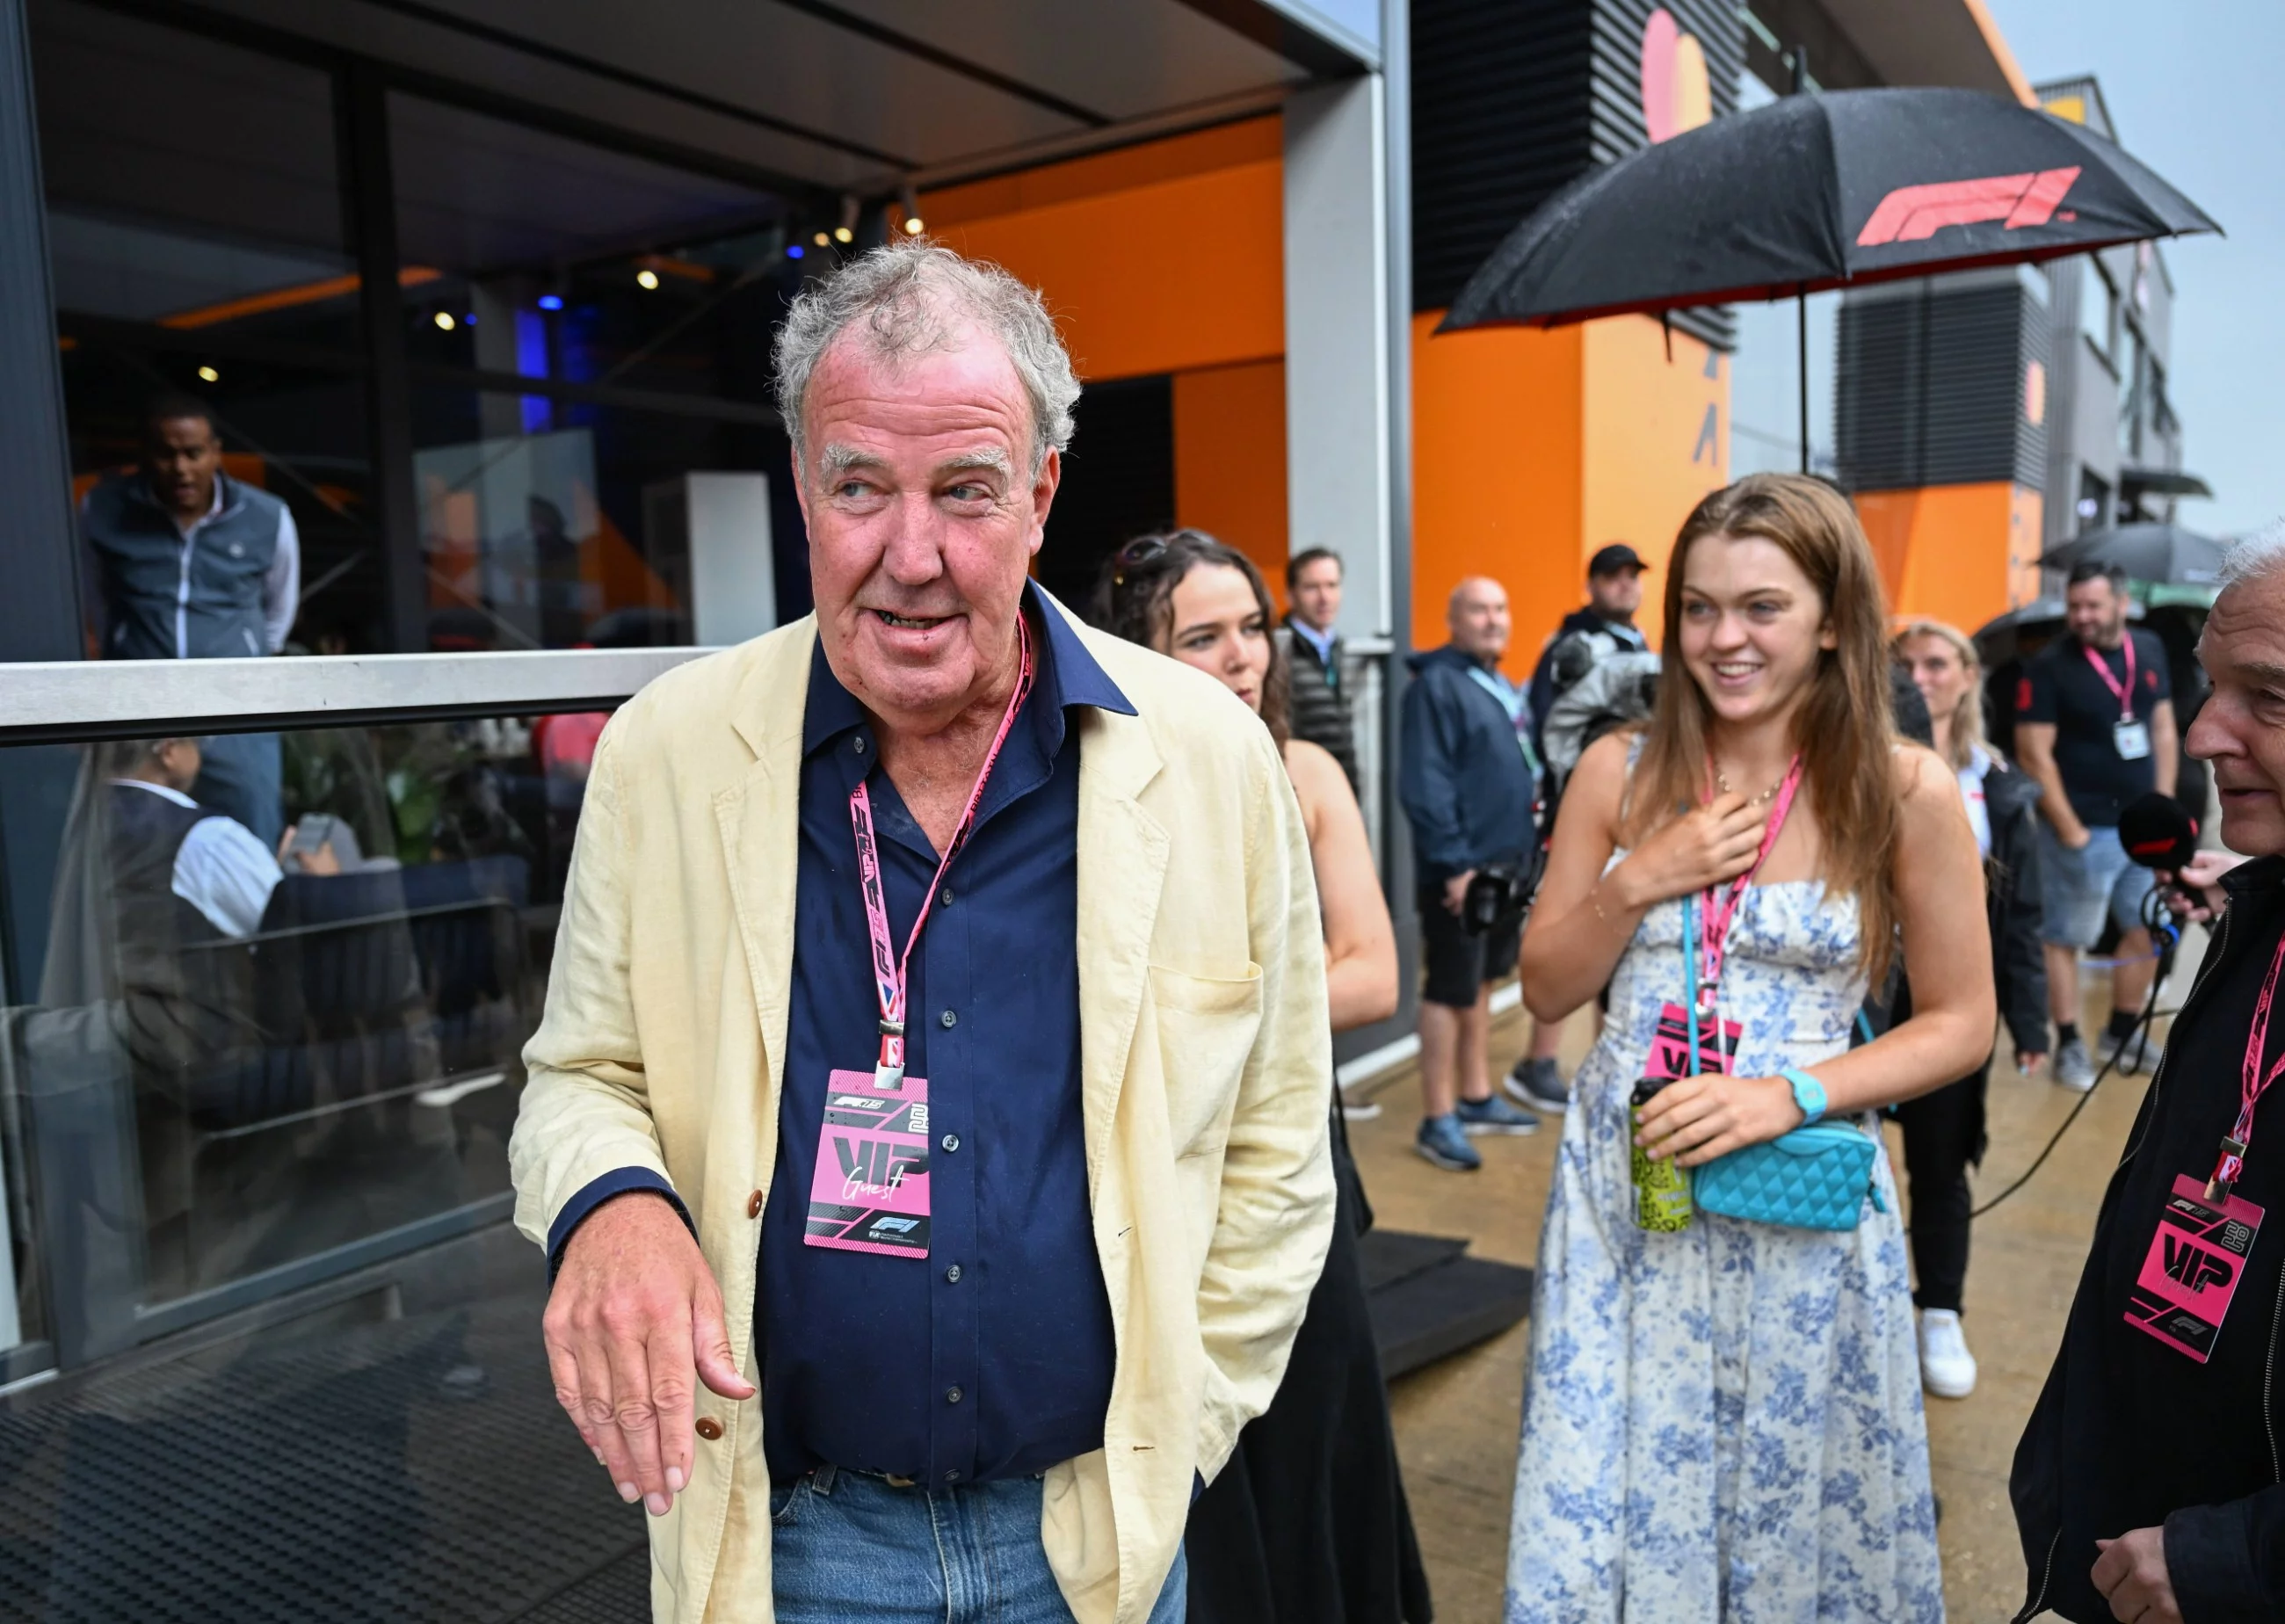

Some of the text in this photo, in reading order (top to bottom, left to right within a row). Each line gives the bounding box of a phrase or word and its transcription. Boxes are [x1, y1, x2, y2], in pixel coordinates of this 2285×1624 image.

[862, 853, 877, 883] VIP
[832, 1136, 930, 1187] VIP
[842, 1165, 910, 1202] Guest
[2164, 1233, 2233, 1294] VIP
